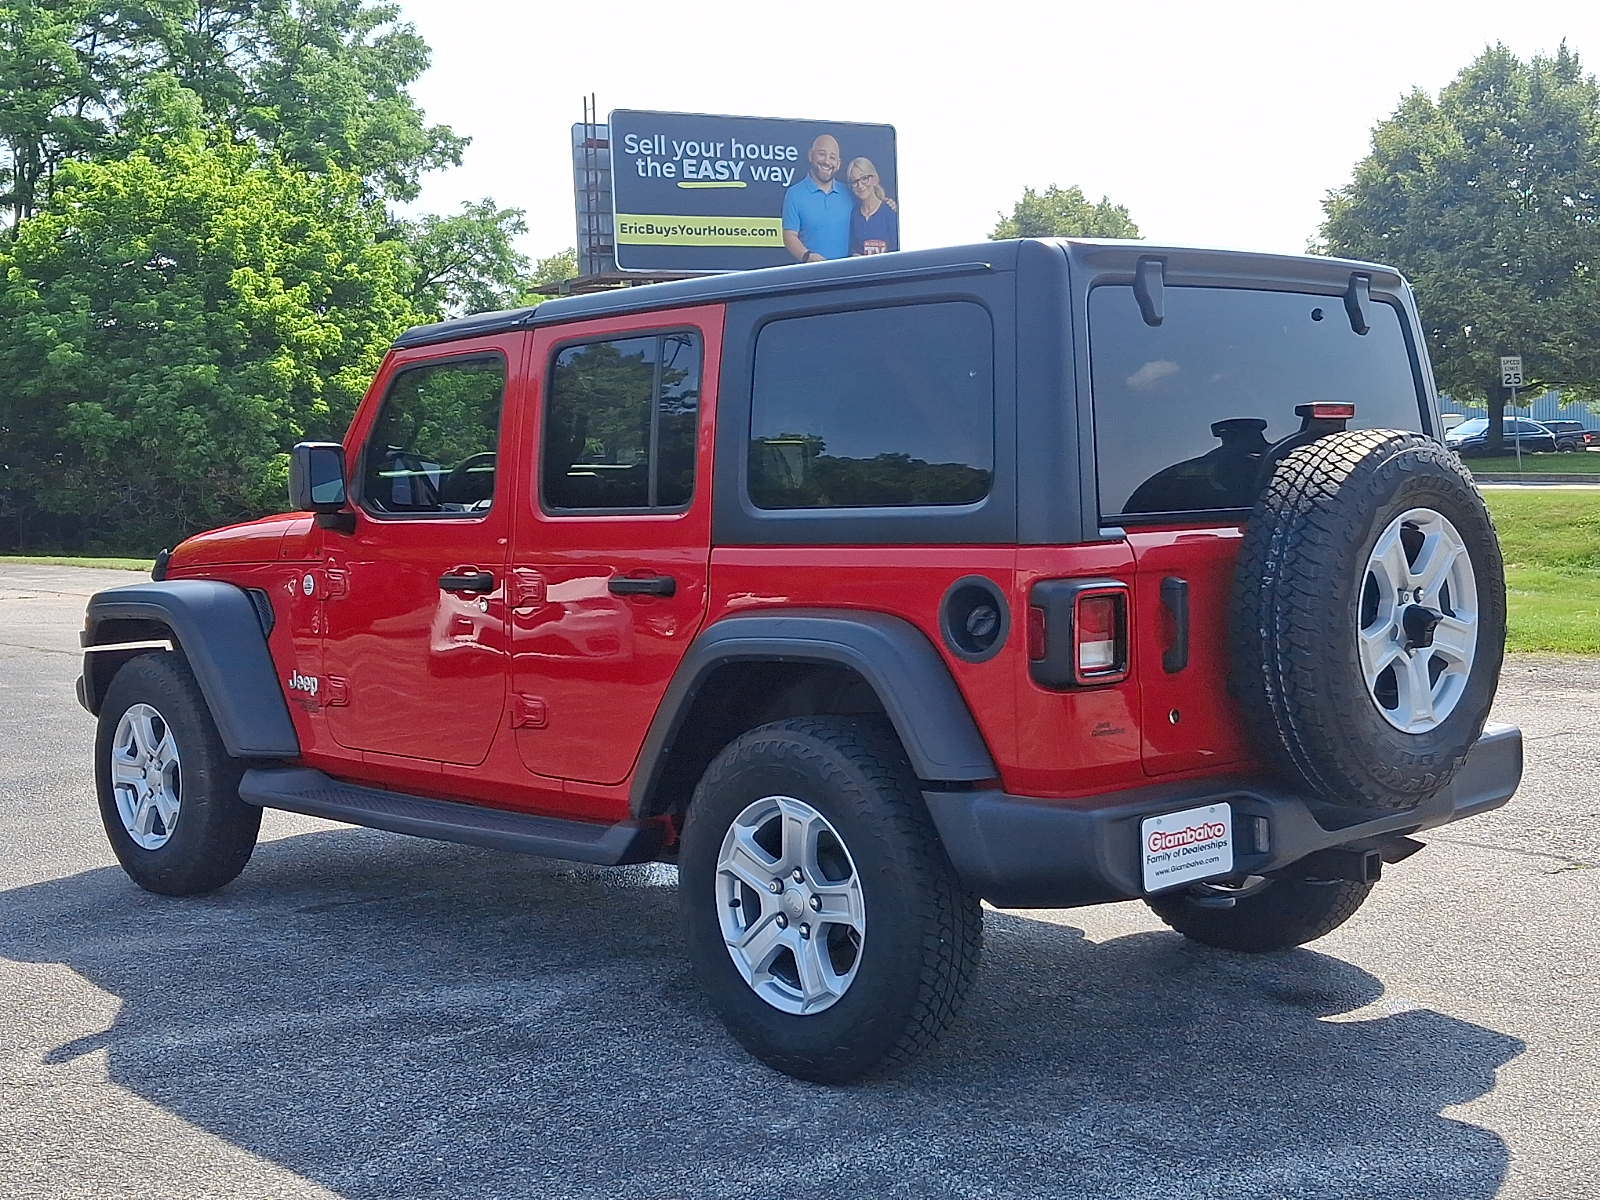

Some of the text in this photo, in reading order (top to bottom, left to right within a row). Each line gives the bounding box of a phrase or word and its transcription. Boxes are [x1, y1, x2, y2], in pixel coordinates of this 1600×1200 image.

[624, 133, 798, 161] Sell your house
[636, 156, 795, 187] the EASY way
[619, 222, 778, 238] EricBuysYourHouse.com
[1504, 373, 1521, 385] 25
[288, 669, 318, 697] Jeep
[1148, 822, 1226, 852] Giambalvo
[1146, 840, 1228, 865] Family of Dealerships
[1155, 856, 1220, 877] www.Giambalvo.com
